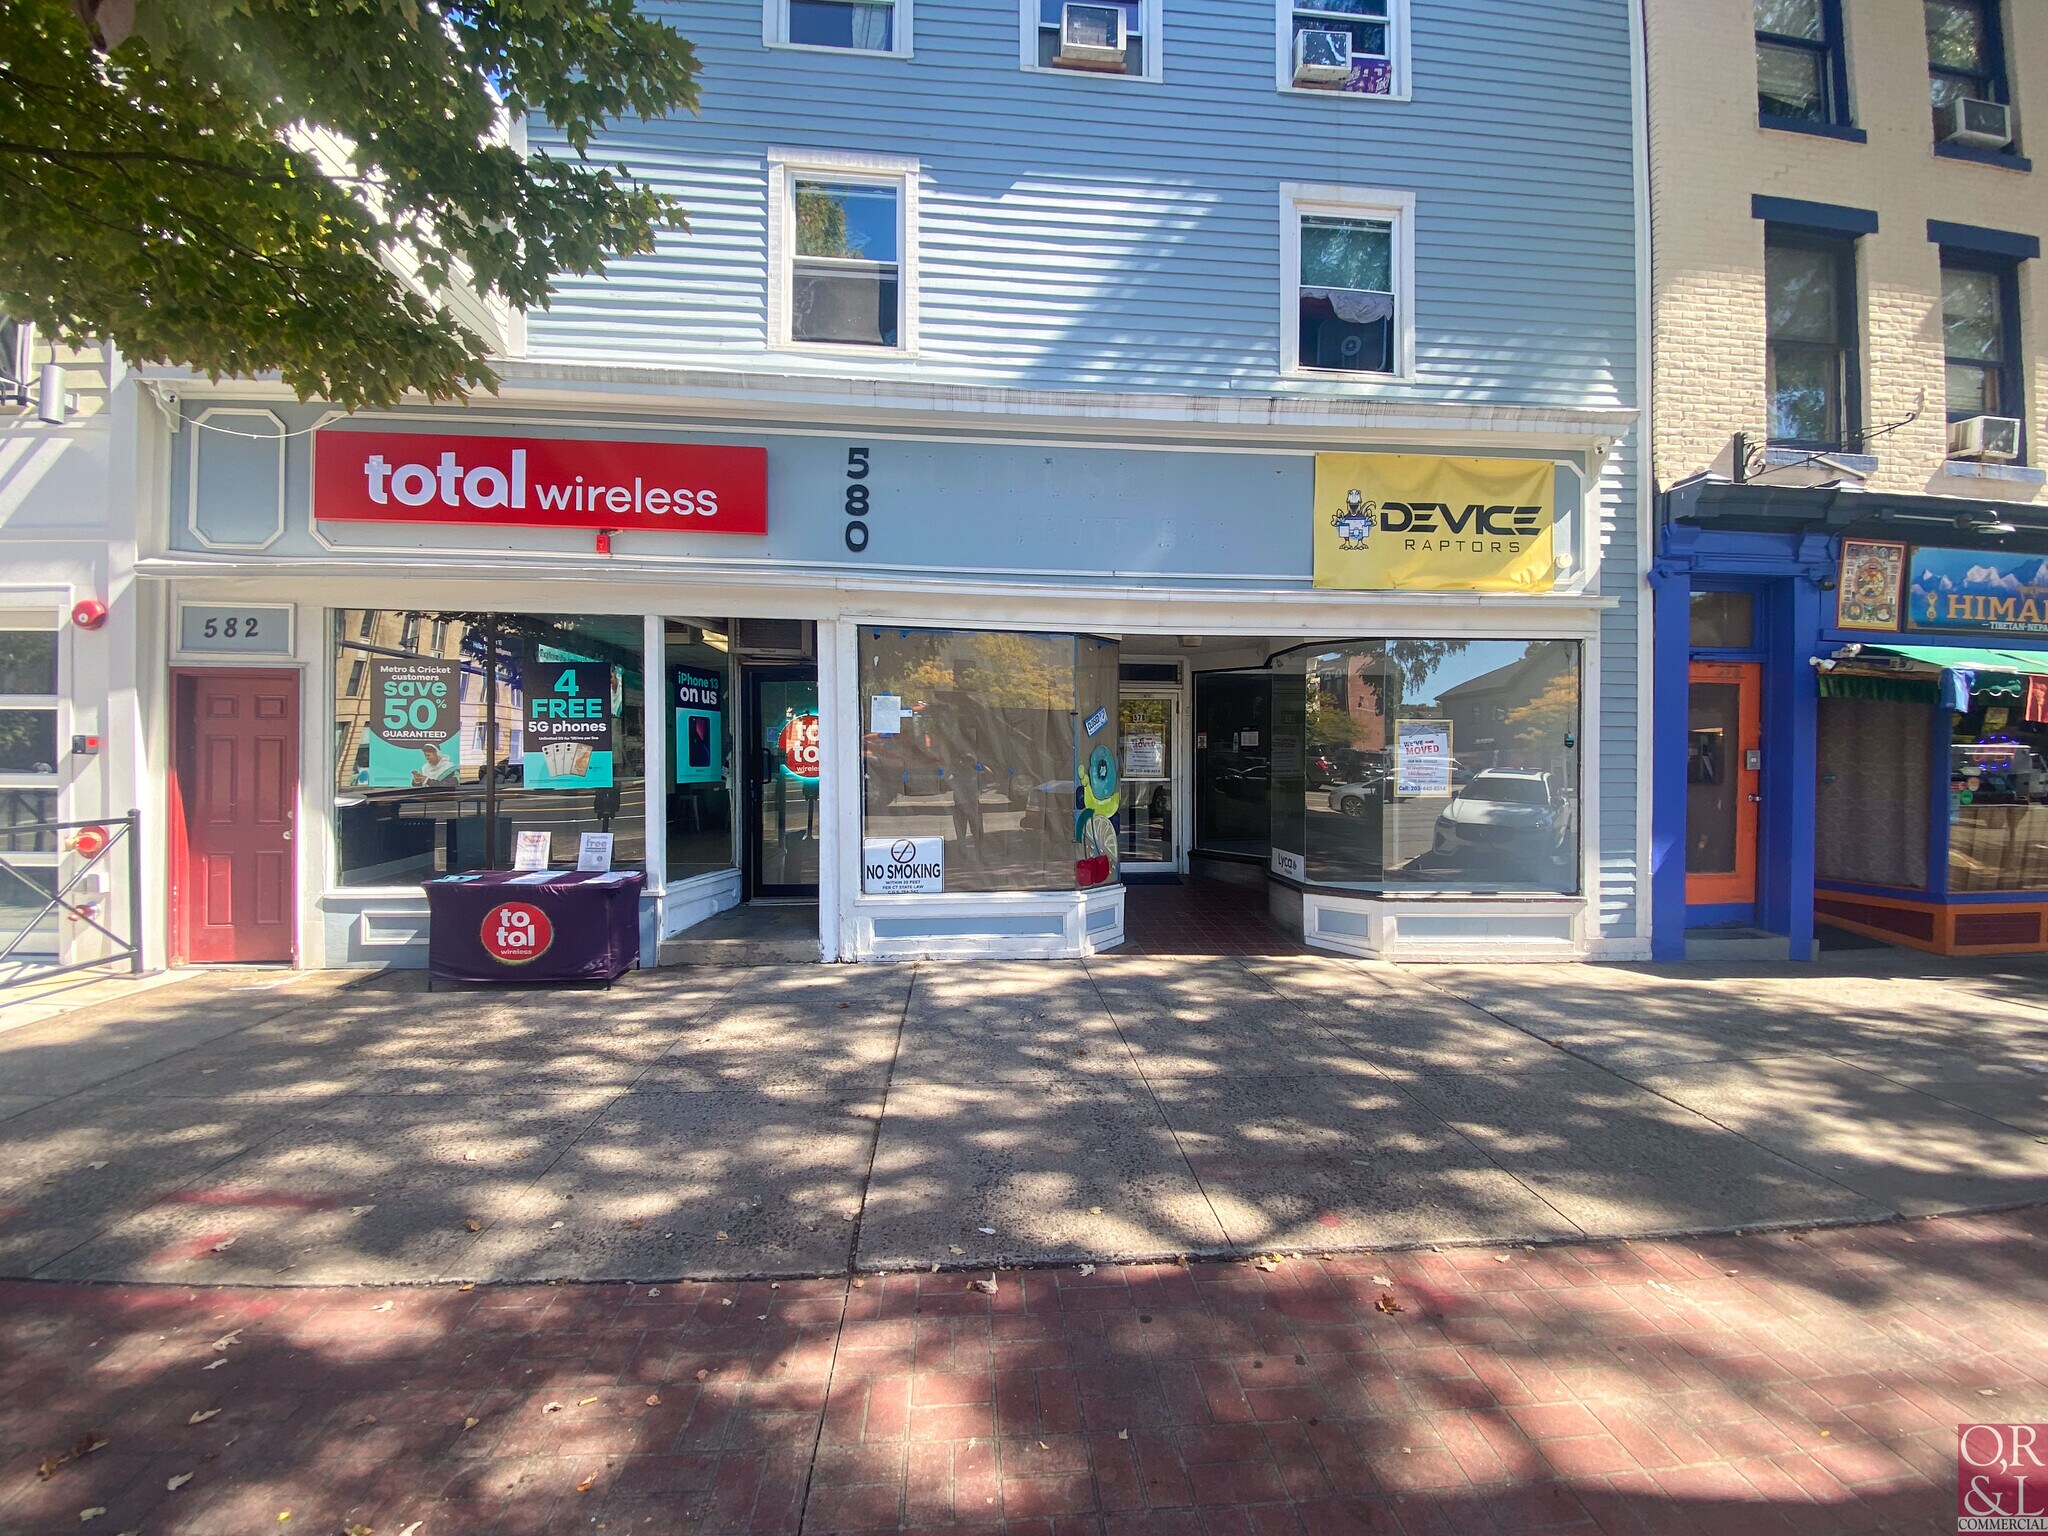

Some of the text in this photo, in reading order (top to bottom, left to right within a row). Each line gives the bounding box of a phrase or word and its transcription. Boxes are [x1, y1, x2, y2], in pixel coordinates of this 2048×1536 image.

[364, 449, 718, 516] total wireless
[845, 447, 870, 552] 580
[1381, 502, 1542, 536] DEVICE
[1405, 539, 1520, 553] RAPTORS
[204, 617, 259, 638] 582
[380, 665, 408, 673] Metro
[417, 665, 451, 674] Cricket
[391, 673, 440, 681] customers
[383, 681, 447, 697] save
[553, 669, 580, 697] 4
[678, 672, 719, 689] iPhone 13
[680, 687, 718, 705] on us
[531, 698, 603, 719] FREE
[382, 730, 447, 738] GUARANTEED
[528, 720, 607, 735] 5G phones
[796, 721, 819, 740] to
[793, 741, 819, 763] ta
[1406, 745, 1440, 755] MOVED
[586, 839, 607, 847] free
[1278, 853, 1293, 868] Lyca
[866, 863, 941, 880] NO SMOKING
[500, 908, 530, 927] to
[496, 924, 535, 947] tal
